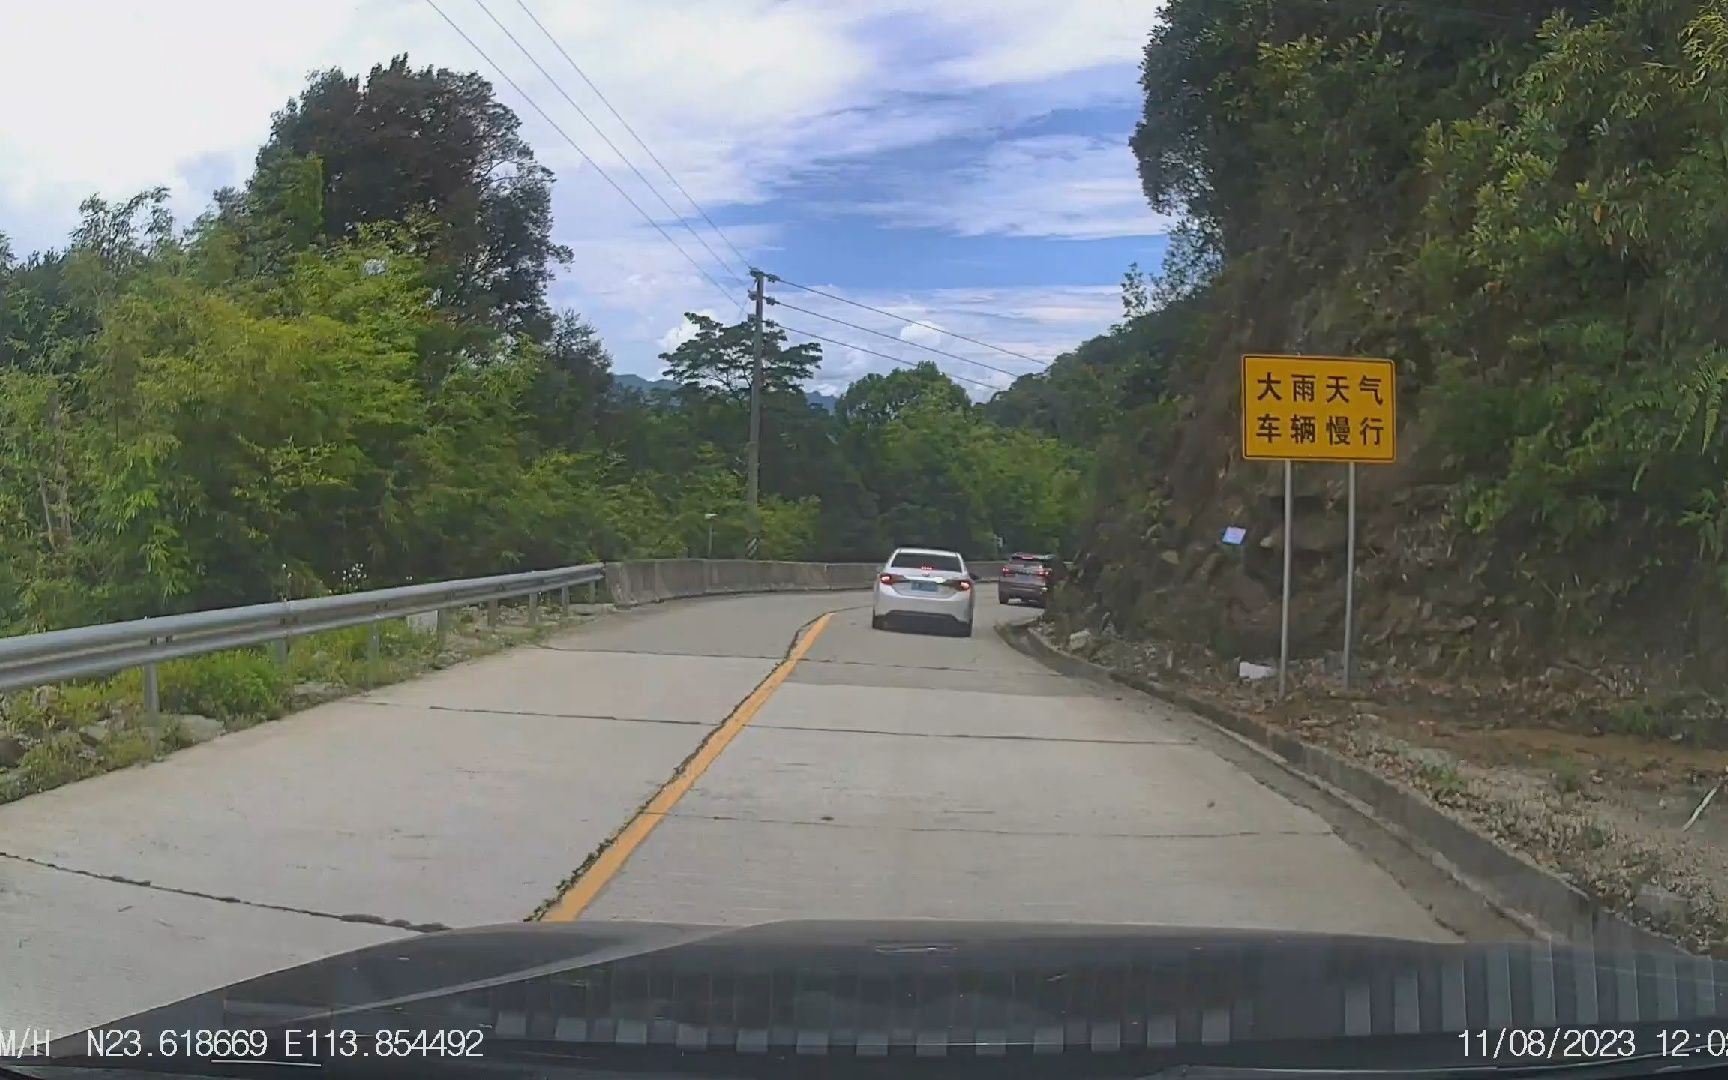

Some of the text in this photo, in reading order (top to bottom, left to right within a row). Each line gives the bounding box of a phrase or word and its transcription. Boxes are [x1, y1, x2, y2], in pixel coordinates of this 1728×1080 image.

[1257, 371, 1384, 406] 大雨天气
[1256, 413, 1384, 446] 车辆慢行
